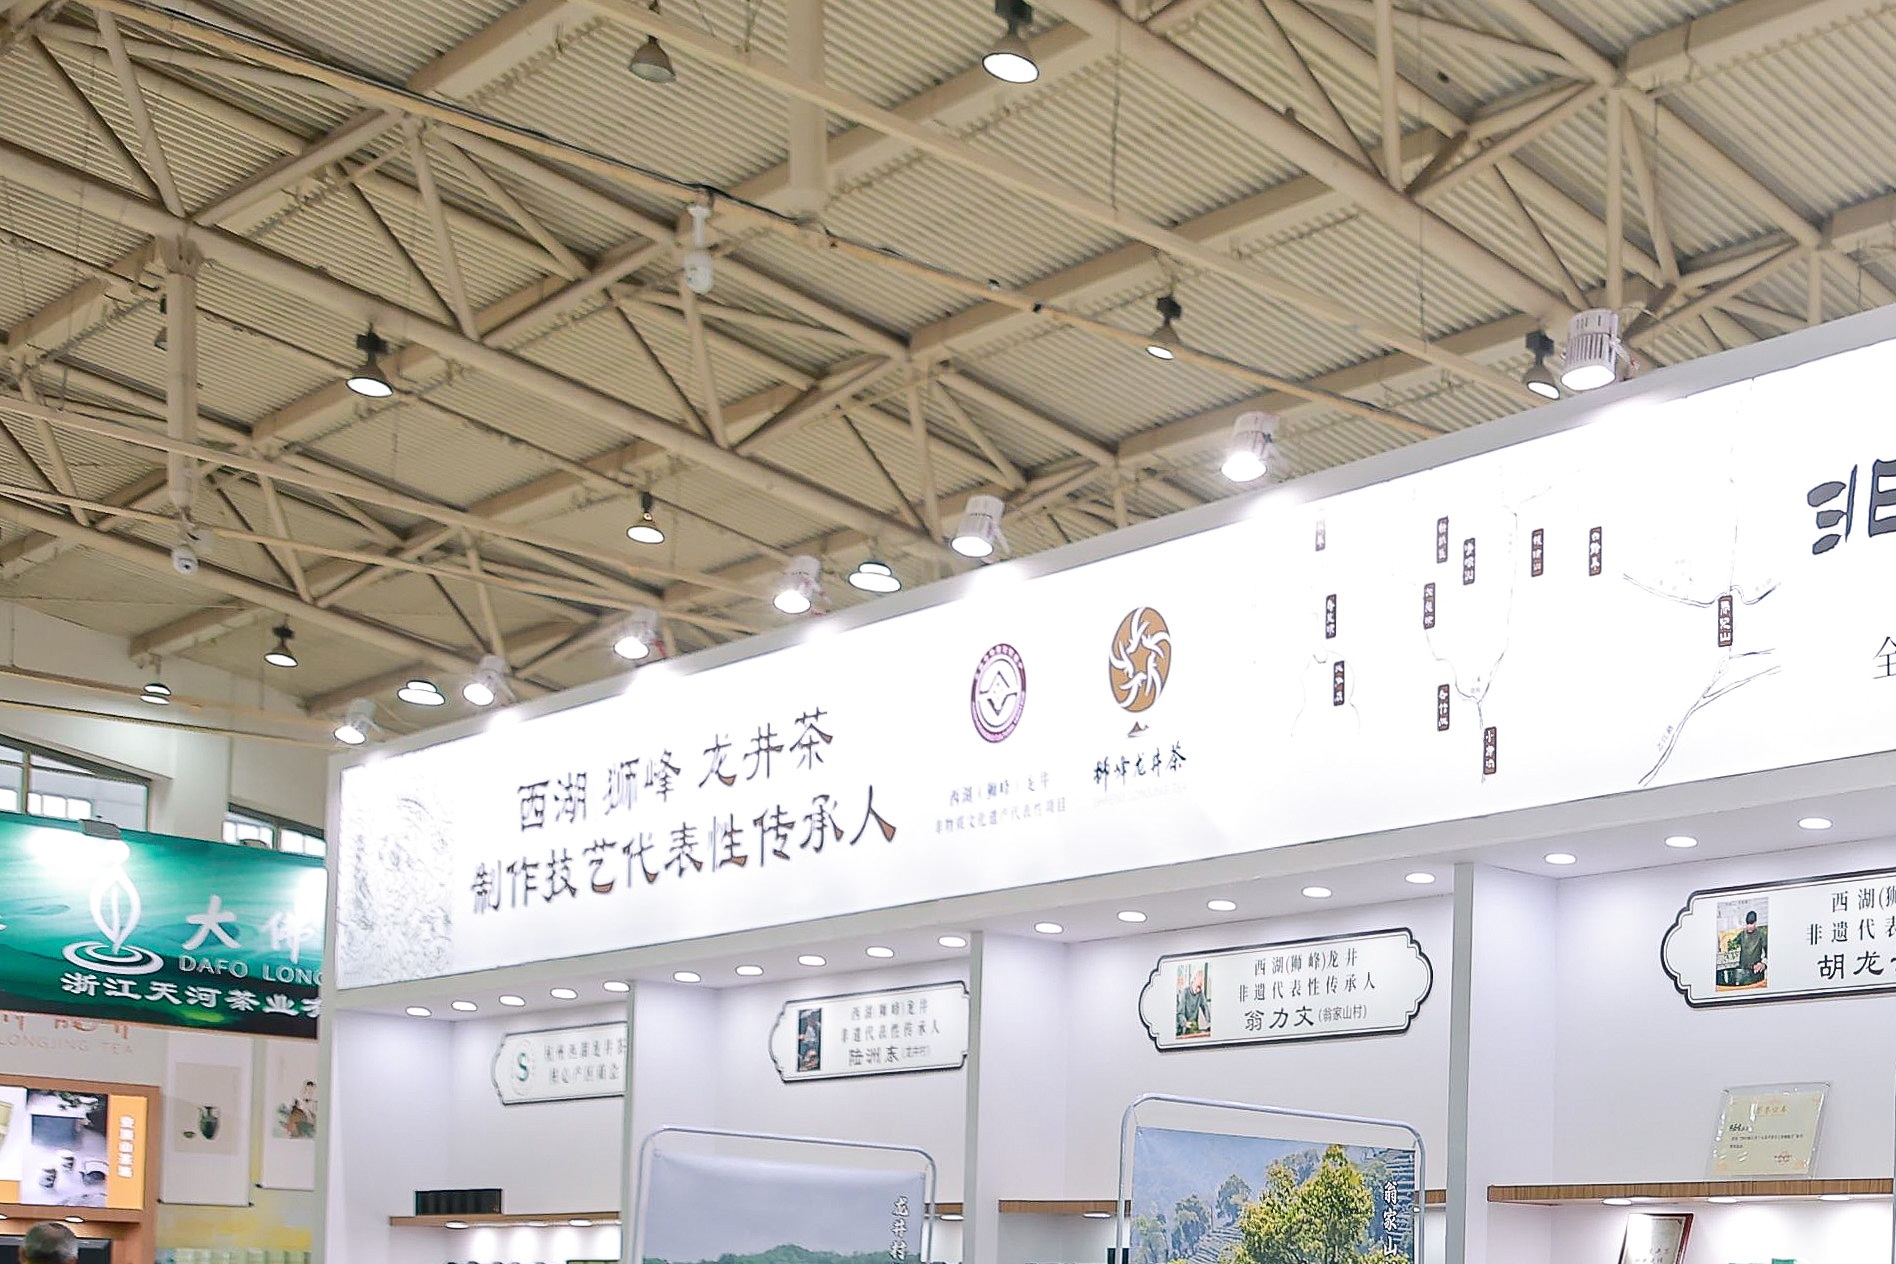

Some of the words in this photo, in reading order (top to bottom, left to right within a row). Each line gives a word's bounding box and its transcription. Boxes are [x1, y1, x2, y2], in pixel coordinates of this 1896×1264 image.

[470, 784, 897, 915] 制作技艺代表性传承人
[178, 955, 249, 979] DAFO
[1238, 971, 1376, 1003] 非遗代表性传承人
